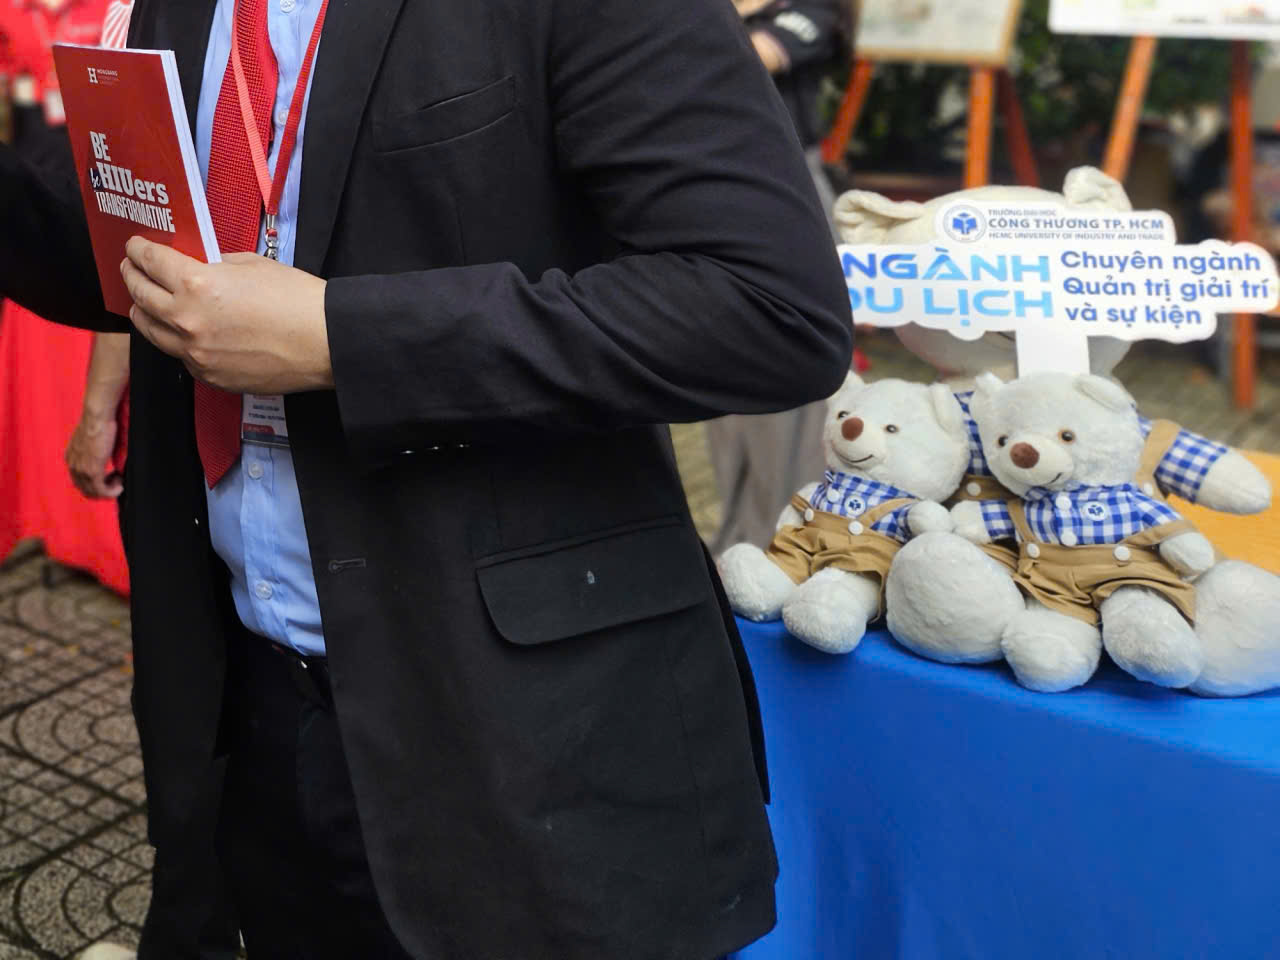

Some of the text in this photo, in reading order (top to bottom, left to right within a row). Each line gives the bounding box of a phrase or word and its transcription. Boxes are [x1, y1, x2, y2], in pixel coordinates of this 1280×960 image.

[90, 131, 111, 161] BE
[96, 161, 169, 205] HIUers
[96, 191, 176, 233] TRANSFORMATIVE
[988, 217, 1164, 230] CÔNG THƯƠNG TP. HCM
[1014, 232, 1060, 240] UNIVERSITY
[842, 247, 1050, 281] NGÀNH
[1061, 250, 1260, 275] Chuyên ngành
[1063, 275, 1270, 301] Quản trị giải trí
[923, 288, 1054, 327] LỊCH
[1065, 302, 1201, 328] và sự kiện
